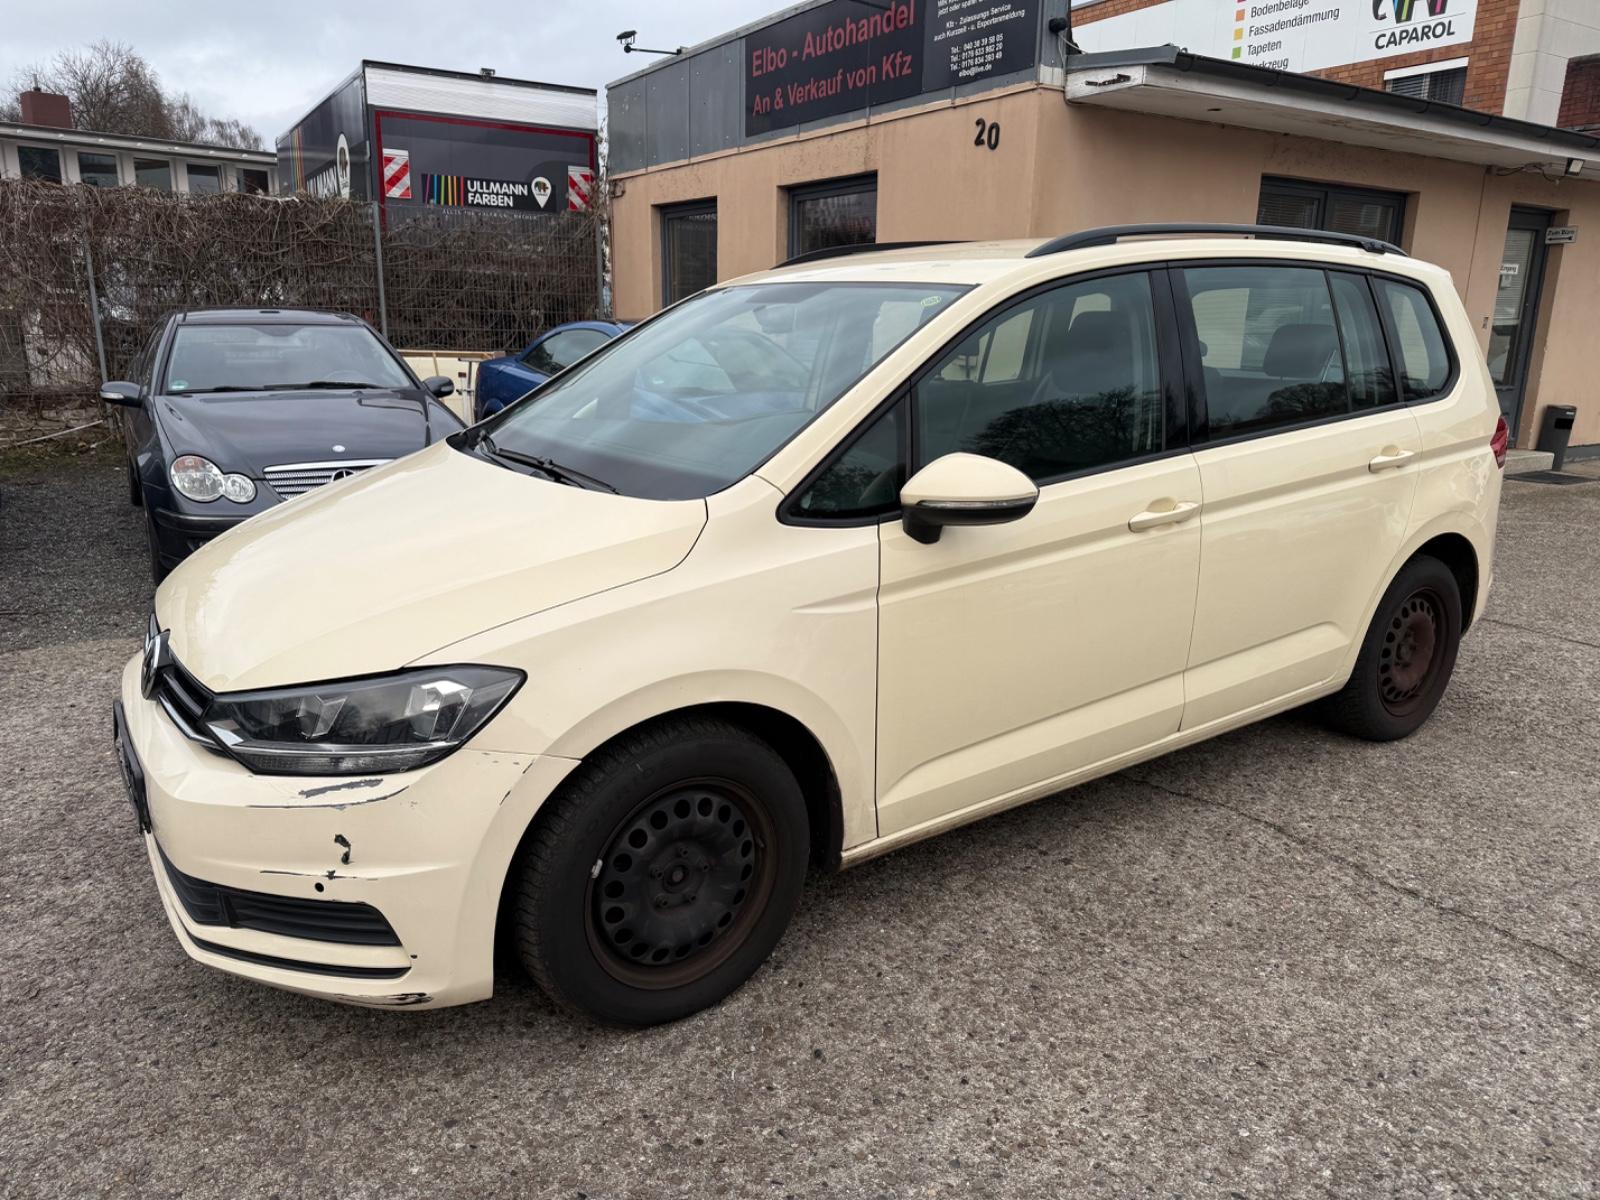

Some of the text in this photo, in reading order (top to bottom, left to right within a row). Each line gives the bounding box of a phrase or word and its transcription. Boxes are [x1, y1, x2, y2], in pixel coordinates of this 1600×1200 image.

[991, 4, 1011, 15] Service
[1248, 8, 1340, 37] Fassadendämmung
[752, 0, 914, 77] Elbo - Autohandel
[1247, 40, 1282, 56] Tapeten
[1374, 20, 1455, 50] CAPAROL
[752, 50, 913, 116] An & Verkauf von Kfz
[974, 117, 1000, 151] 20
[467, 179, 528, 196] ULLMANN
[468, 192, 513, 208] FARBEN
